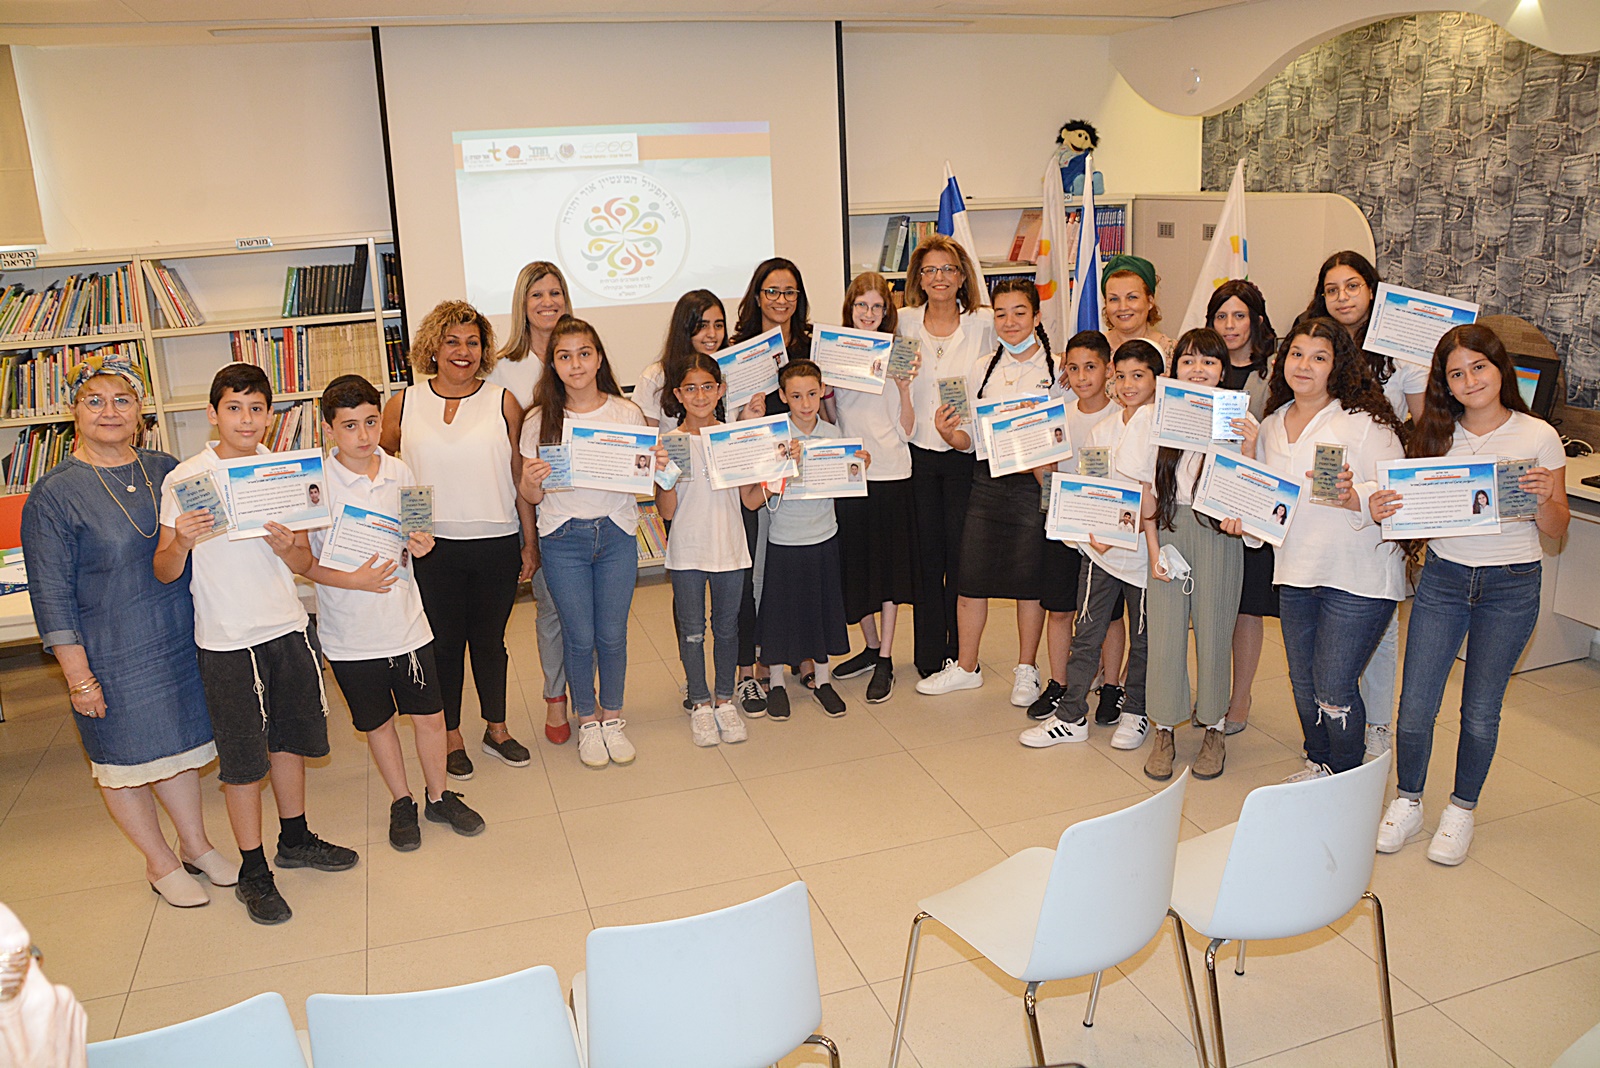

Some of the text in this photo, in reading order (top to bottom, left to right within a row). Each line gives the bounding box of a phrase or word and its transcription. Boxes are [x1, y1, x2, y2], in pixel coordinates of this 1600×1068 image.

[562, 175, 681, 224] אות הפעיל המצטיין אור יהודה
[239, 238, 269, 247] מורשת
[0, 251, 36, 260] בראשית
[3, 258, 32, 267] קריאה
